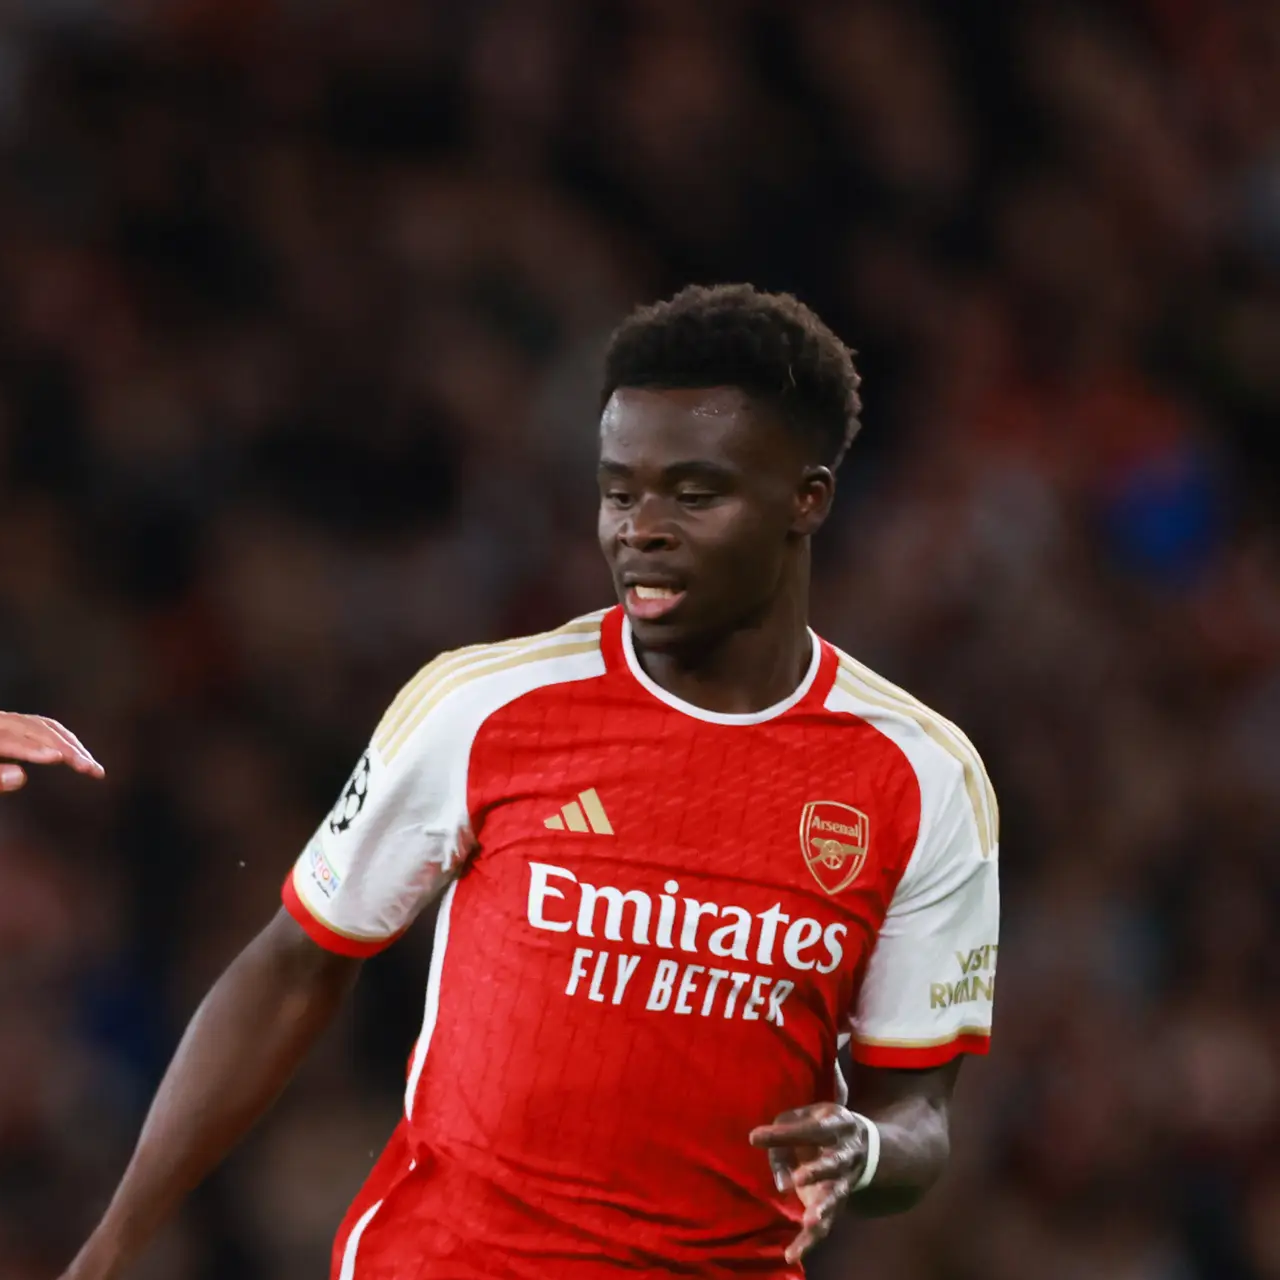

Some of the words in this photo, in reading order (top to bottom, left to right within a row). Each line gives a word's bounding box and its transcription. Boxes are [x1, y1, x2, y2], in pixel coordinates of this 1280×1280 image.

[811, 815, 859, 838] Arsenal
[527, 860, 848, 975] Emirates
[565, 947, 642, 1006] FLY
[645, 958, 795, 1027] BETTER
